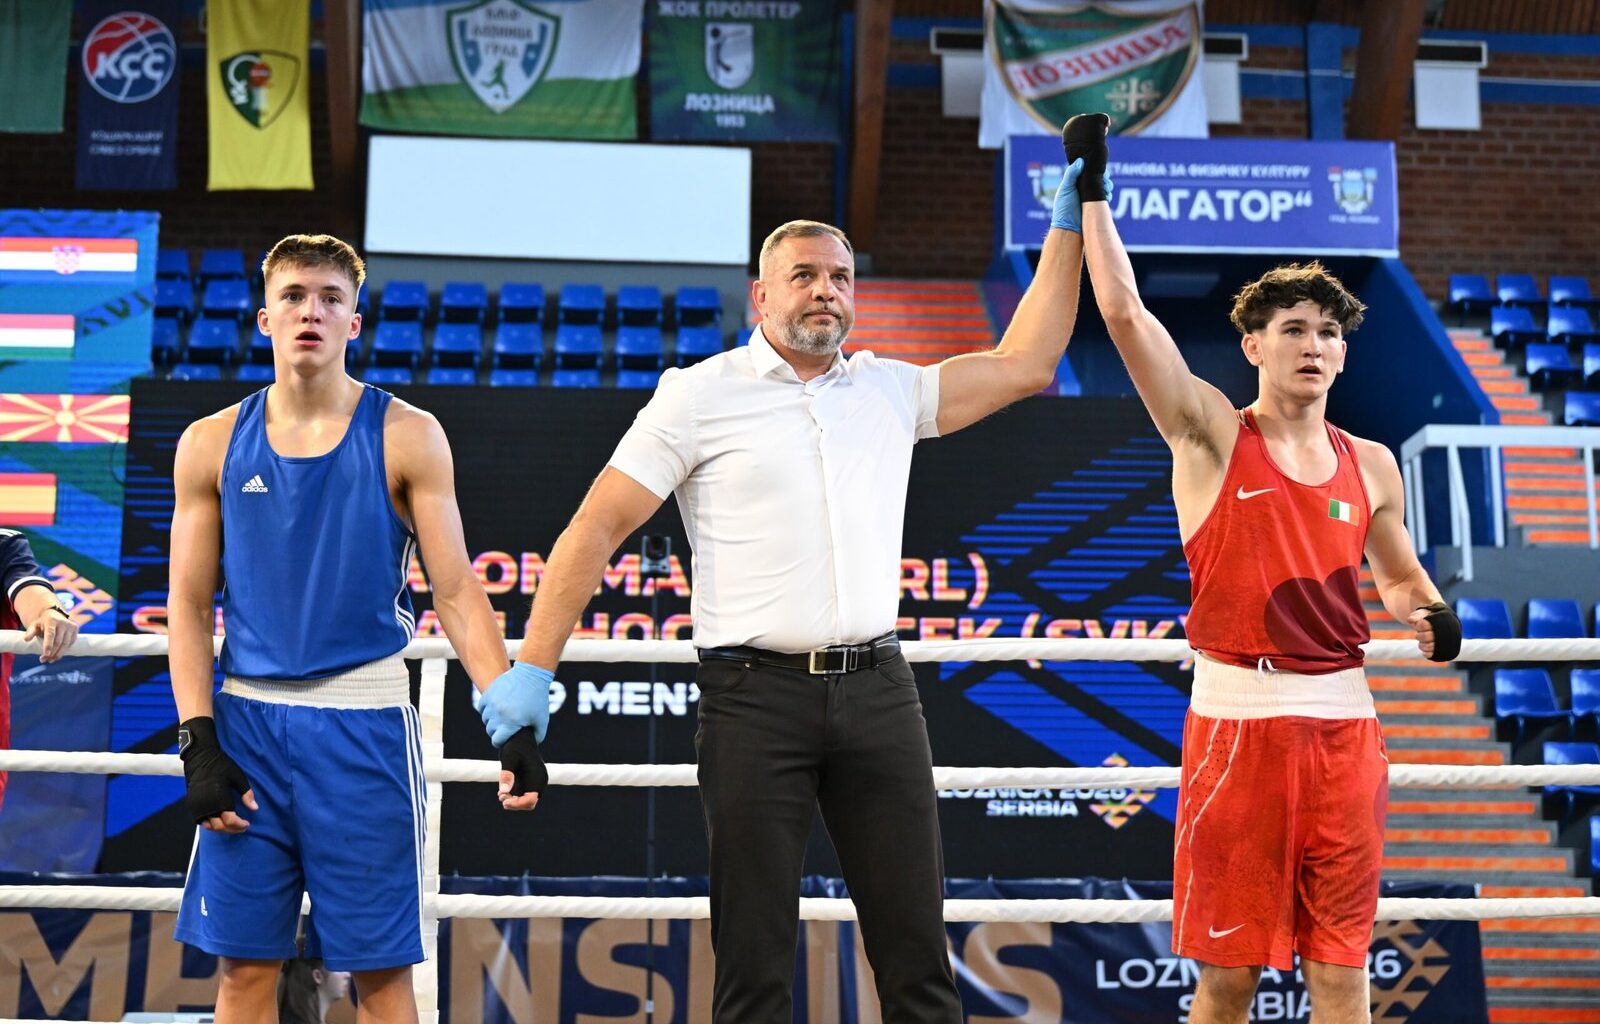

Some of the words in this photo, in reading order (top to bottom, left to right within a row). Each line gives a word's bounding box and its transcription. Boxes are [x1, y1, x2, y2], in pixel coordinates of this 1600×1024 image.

[704, 2, 801, 19] ПРОЛЕТЕР
[685, 93, 775, 114] ЛОЗНИЦА
[1108, 162, 1167, 177] СТАНОВА
[1169, 163, 1186, 177] ЗА
[986, 801, 1079, 817] SERBIA
